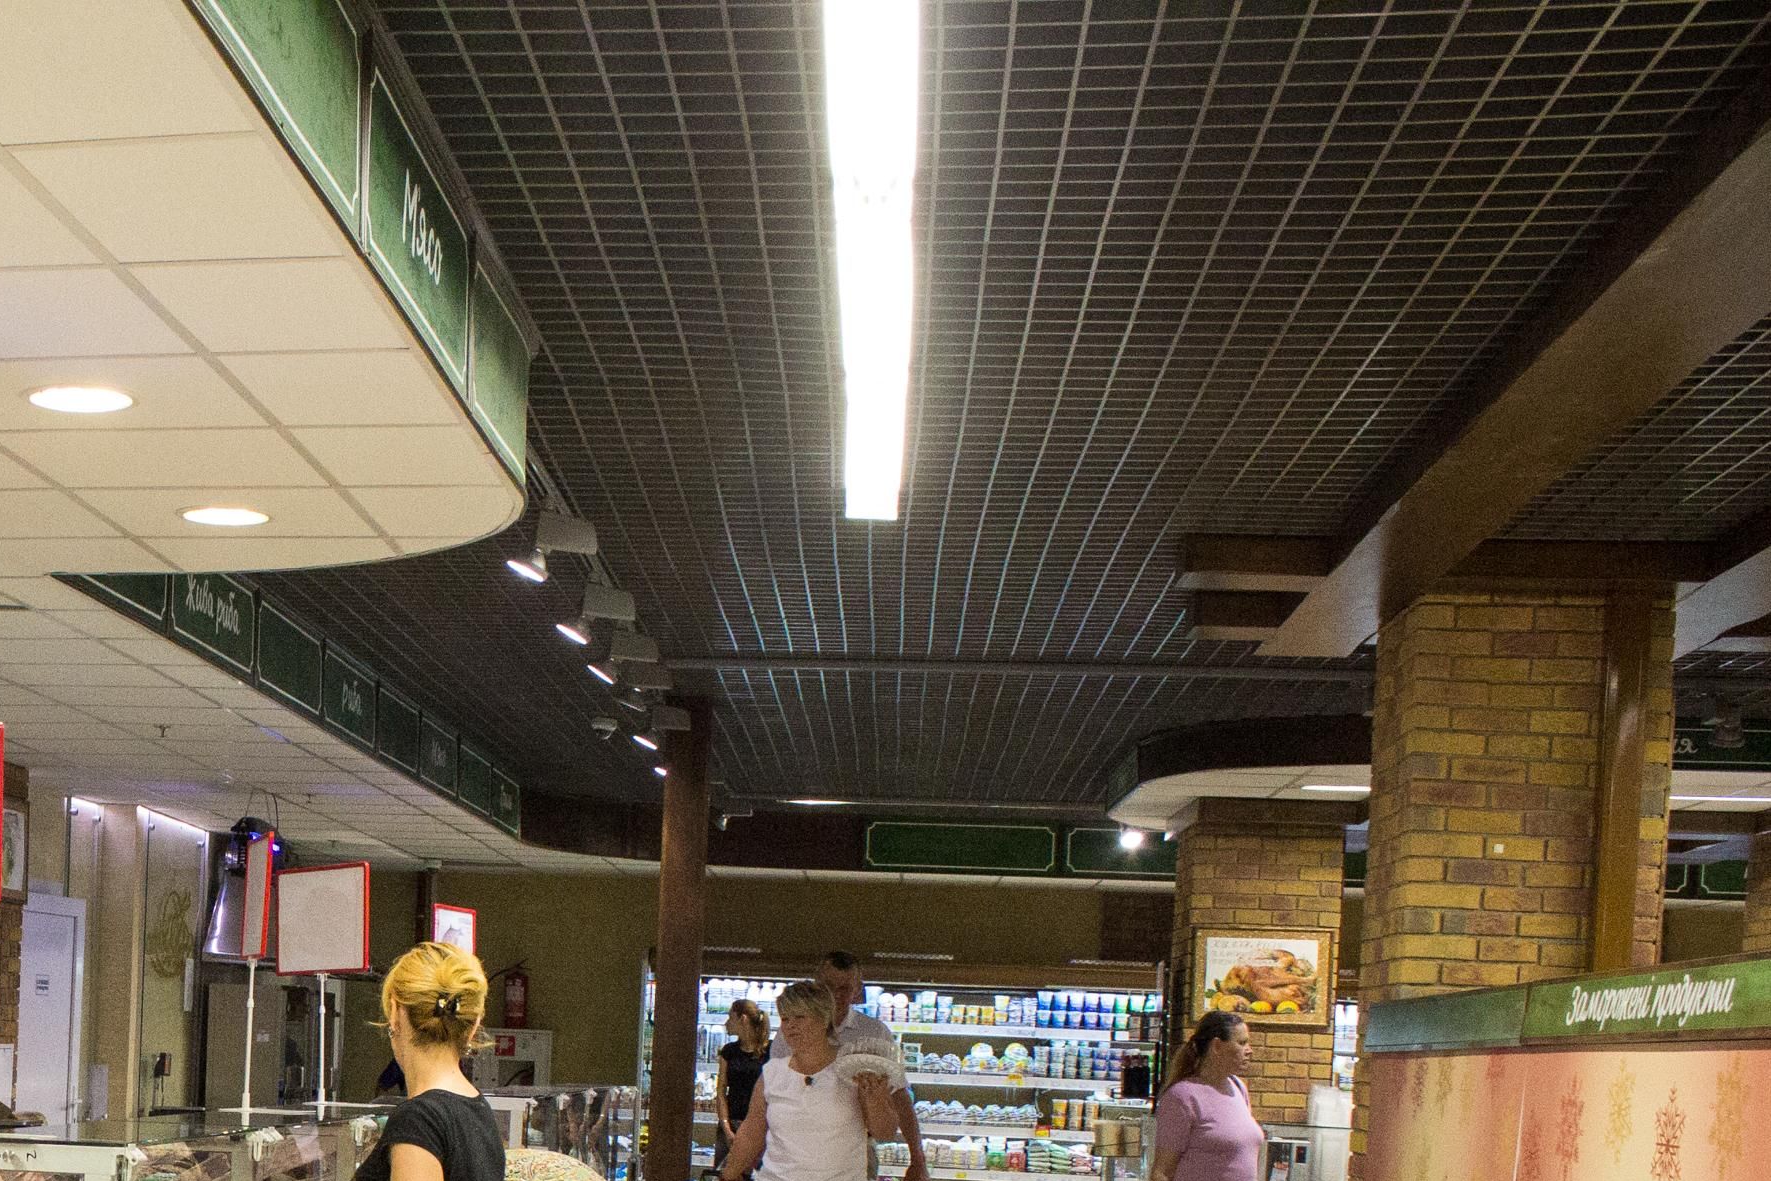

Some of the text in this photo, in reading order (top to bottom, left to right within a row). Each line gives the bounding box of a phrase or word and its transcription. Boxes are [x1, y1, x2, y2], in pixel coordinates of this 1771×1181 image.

[402, 168, 443, 286] М'ясо
[185, 573, 241, 635] Жива риба
[1565, 973, 1736, 1031] Заморожені продукти
